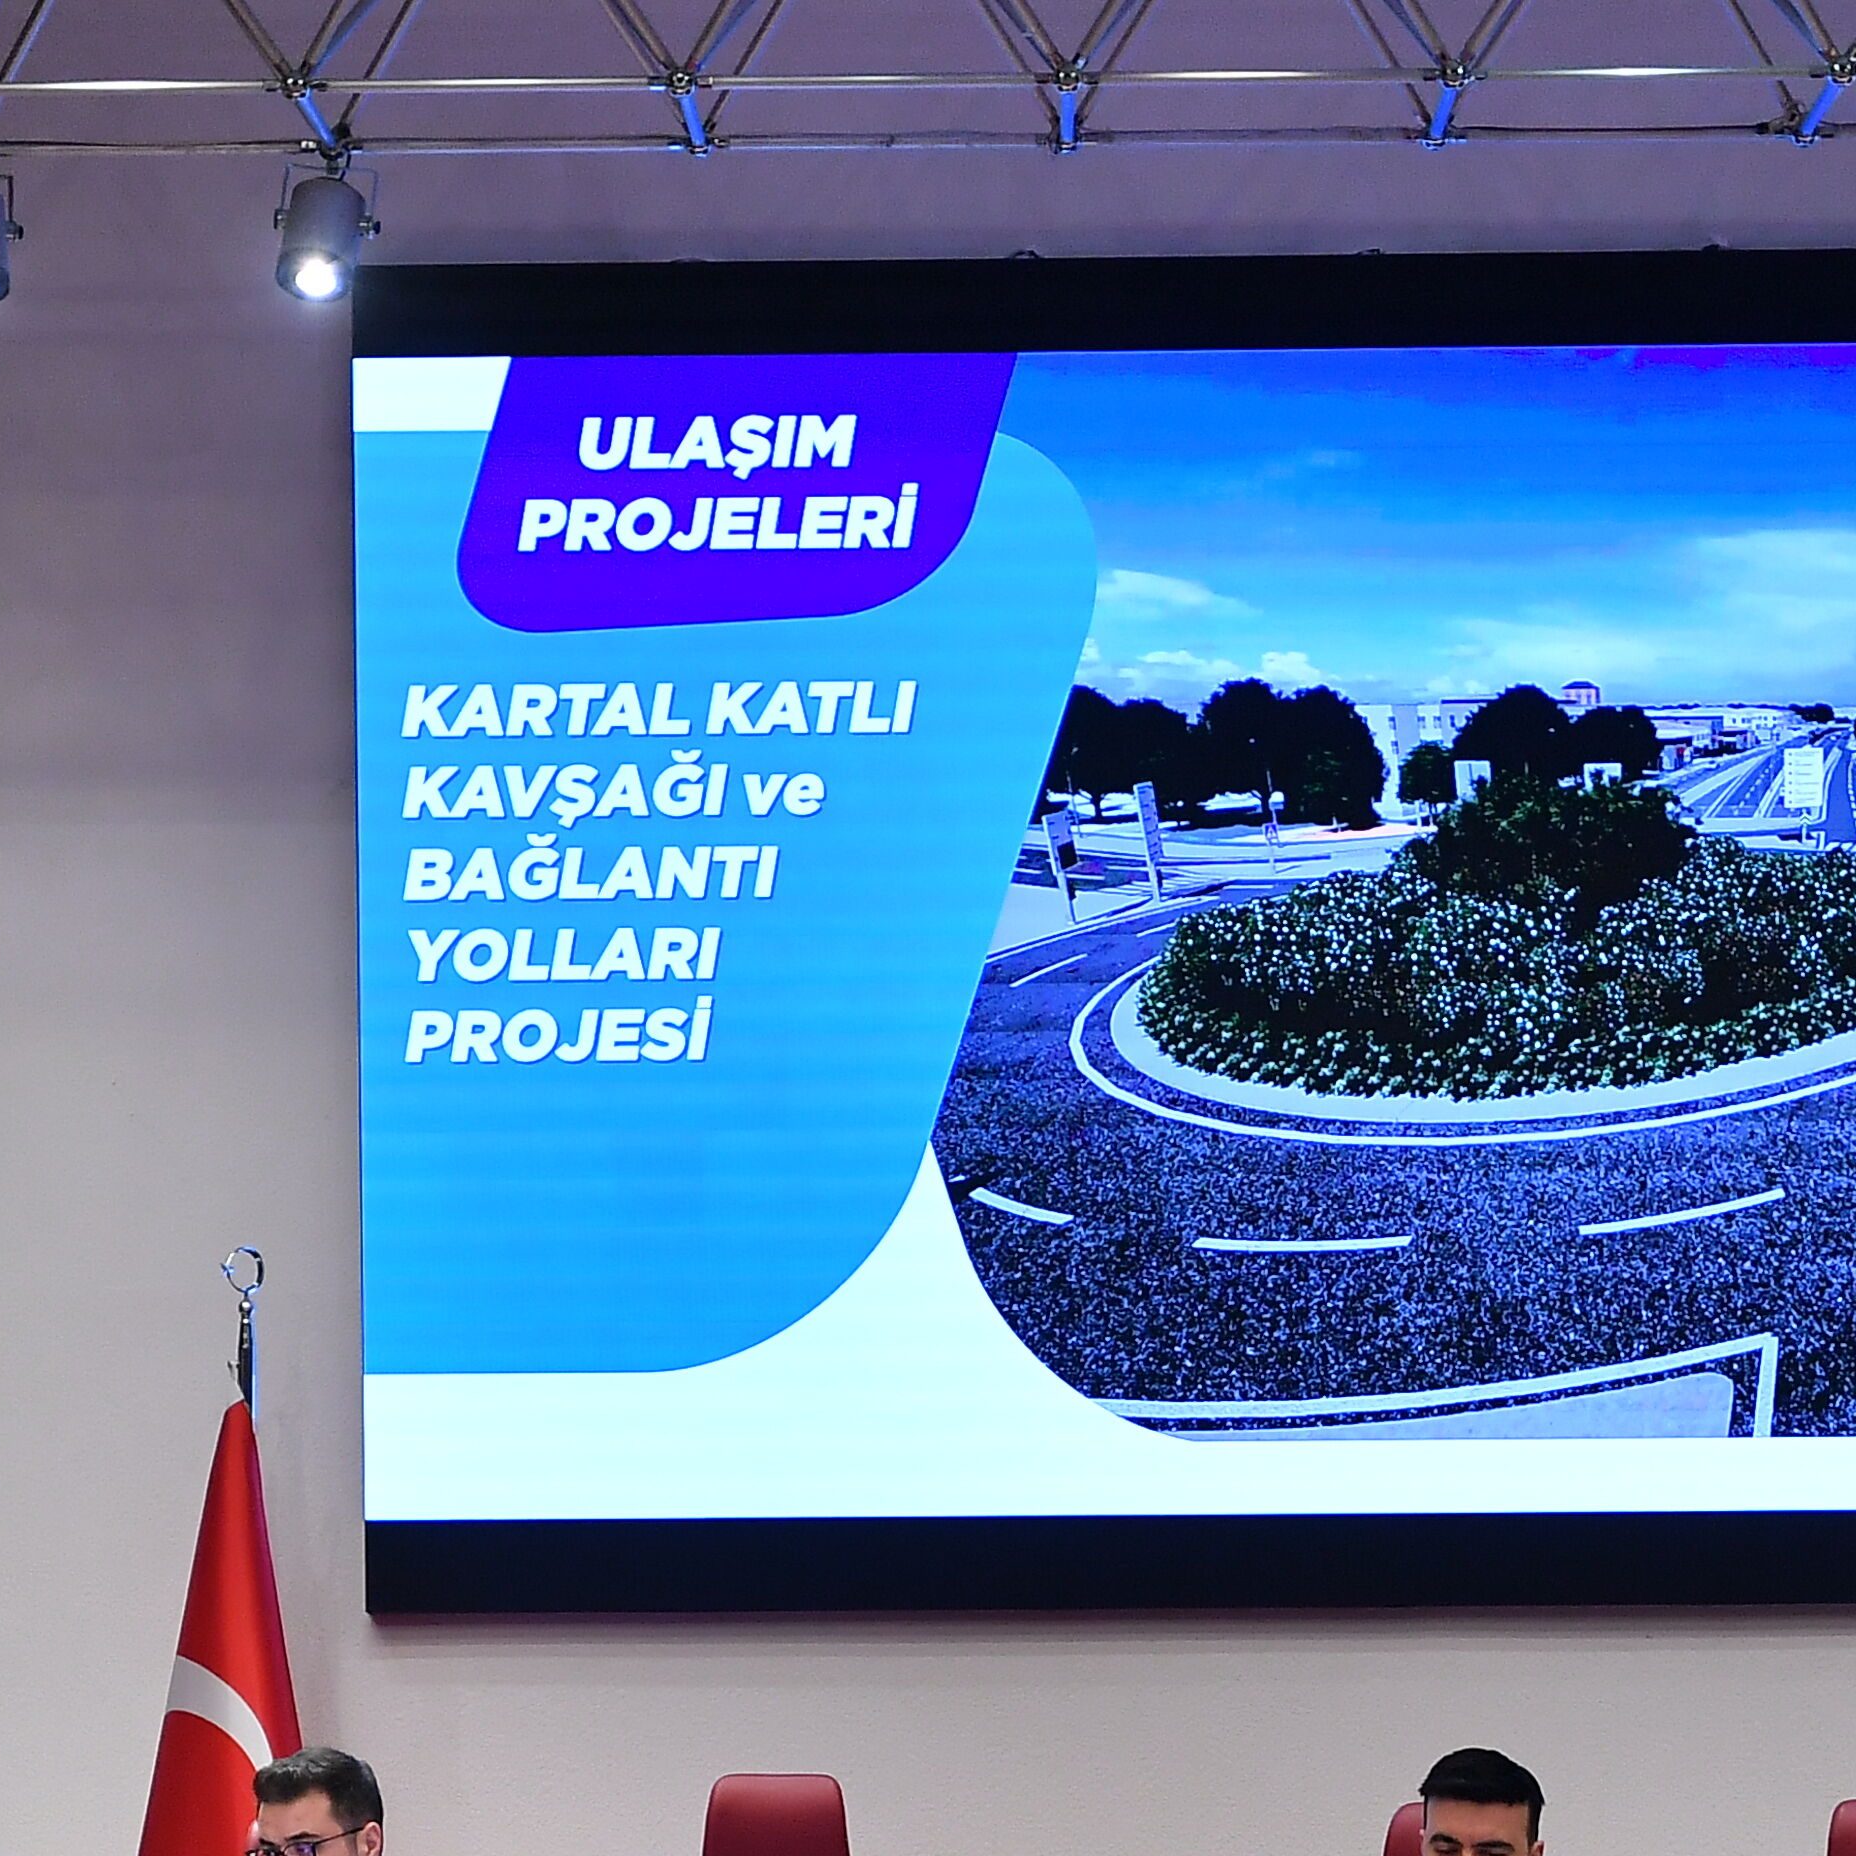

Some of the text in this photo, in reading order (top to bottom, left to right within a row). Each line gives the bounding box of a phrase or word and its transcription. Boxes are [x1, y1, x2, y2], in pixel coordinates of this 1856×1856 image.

[578, 414, 857, 480] ULAŞIM
[517, 483, 919, 552] PROJELERİ
[401, 680, 917, 737] KARTAL KATLI
[402, 749, 825, 828] KAVŞAĞI ve
[403, 834, 779, 901] BAĞLANTI
[408, 927, 721, 982] YOLLARI
[405, 996, 713, 1063] PROJESİ
